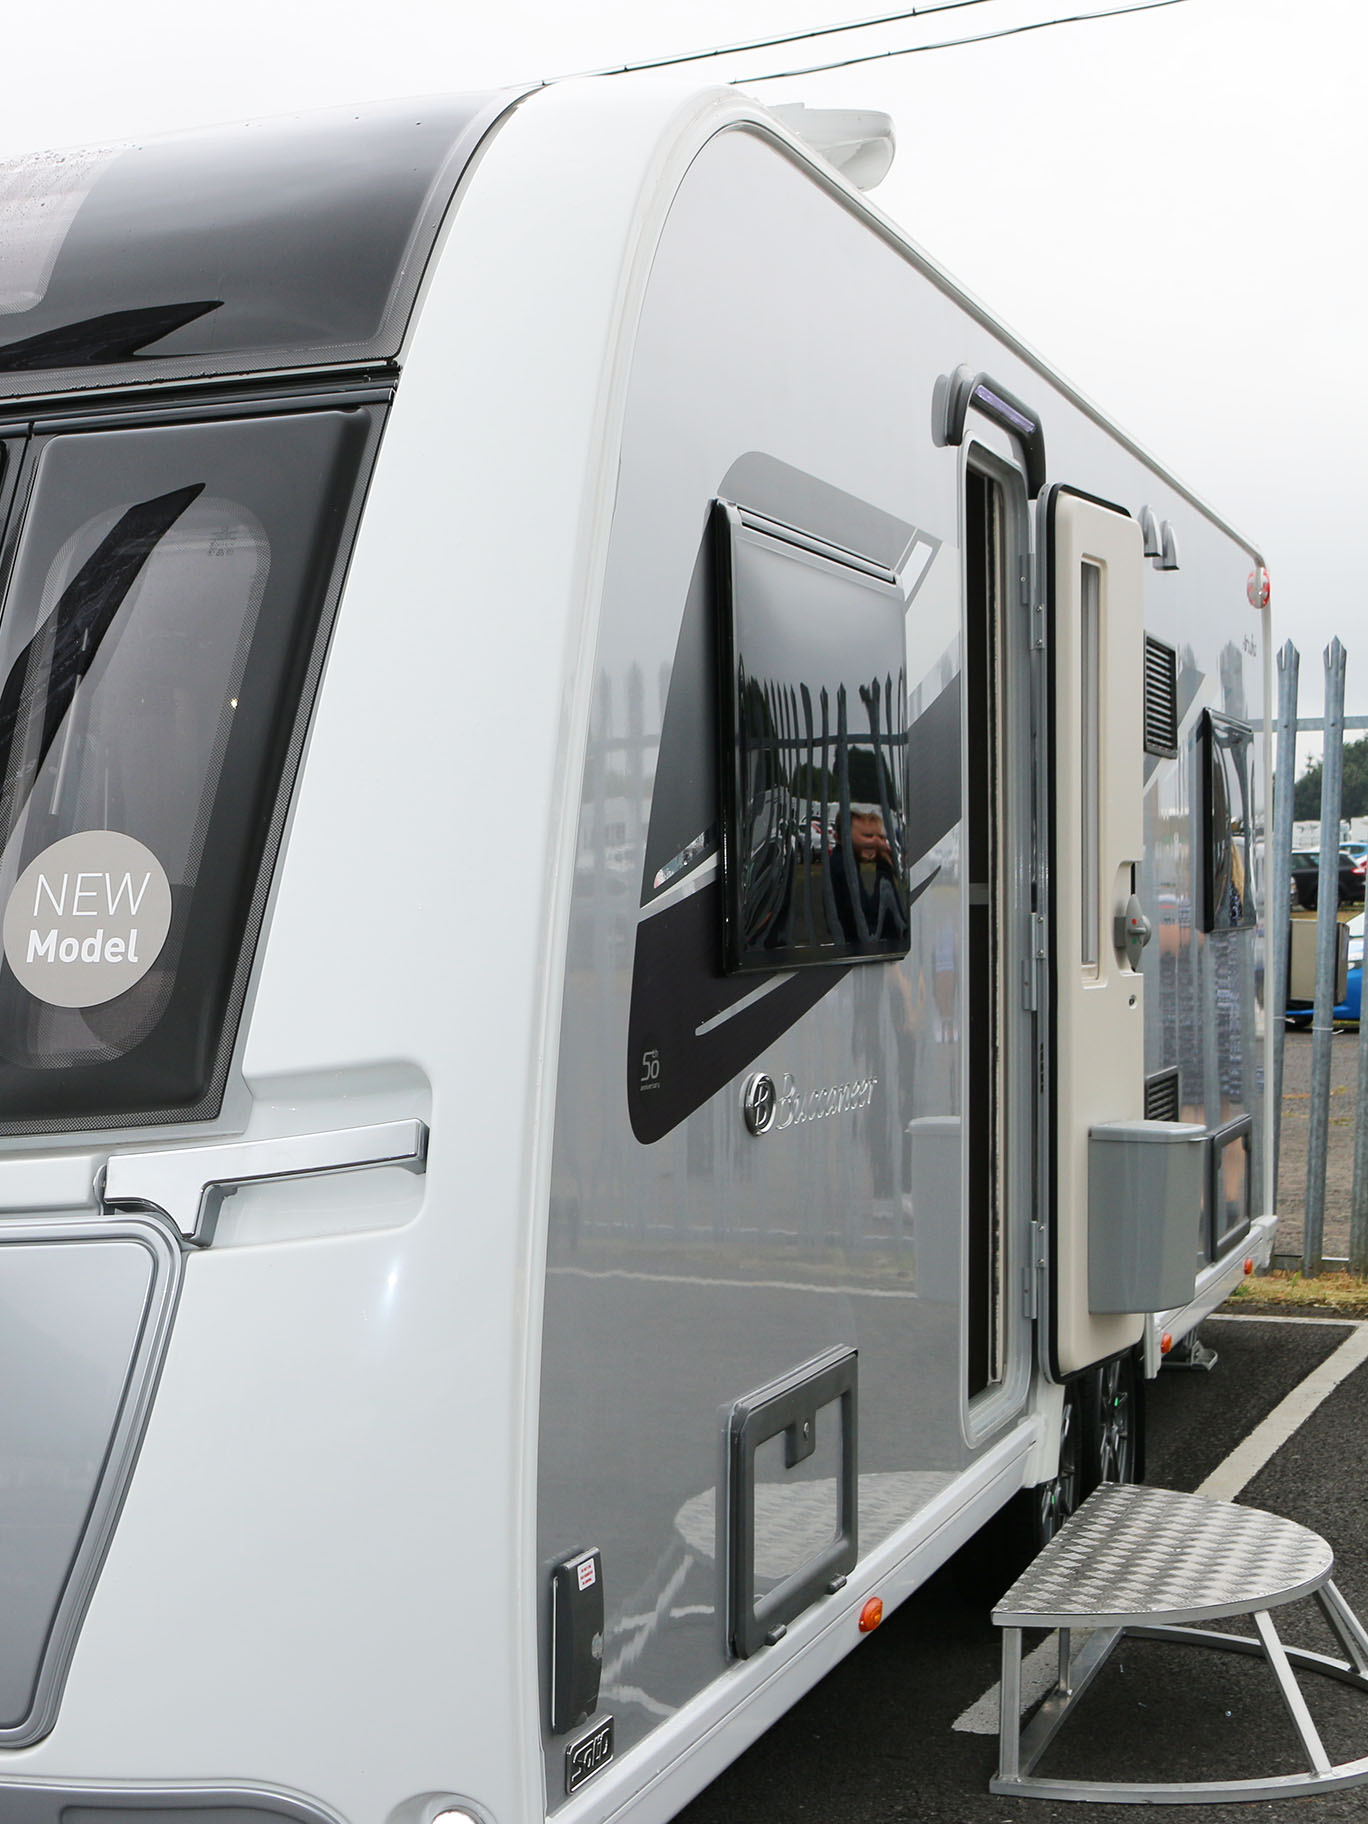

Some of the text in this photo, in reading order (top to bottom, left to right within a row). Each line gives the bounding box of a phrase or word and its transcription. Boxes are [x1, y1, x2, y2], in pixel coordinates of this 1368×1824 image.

[33, 872, 151, 916] NEW
[26, 928, 139, 963] Model
[776, 1072, 878, 1130] Buccaneer
